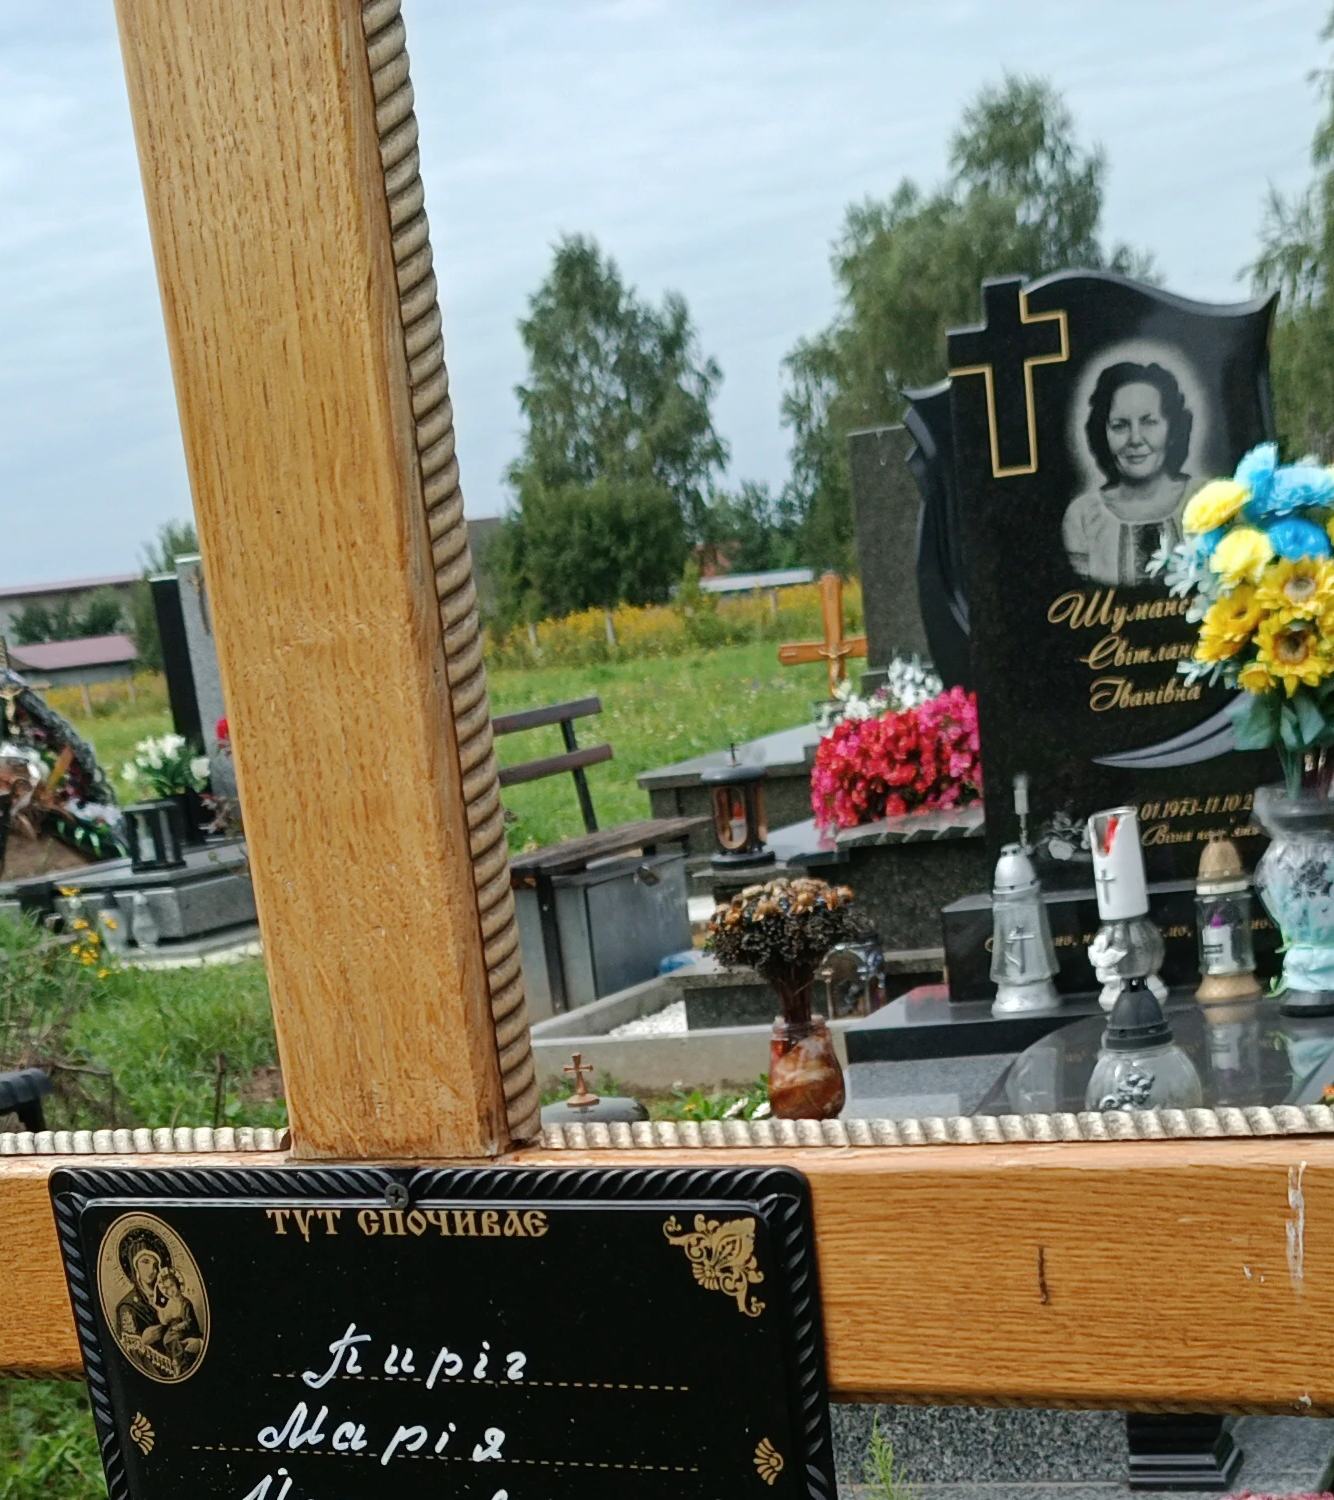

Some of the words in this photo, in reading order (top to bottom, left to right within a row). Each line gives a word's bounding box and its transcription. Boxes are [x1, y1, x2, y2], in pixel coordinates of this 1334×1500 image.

[1047, 588, 1195, 633] Шуманс
[1079, 633, 1198, 670] Світлан
[1089, 676, 1203, 712] Іванівна
[266, 1209, 341, 1242] ТУТ
[357, 1208, 549, 1238] СПОЧИВАЄ
[257, 1401, 506, 1466] Марія
